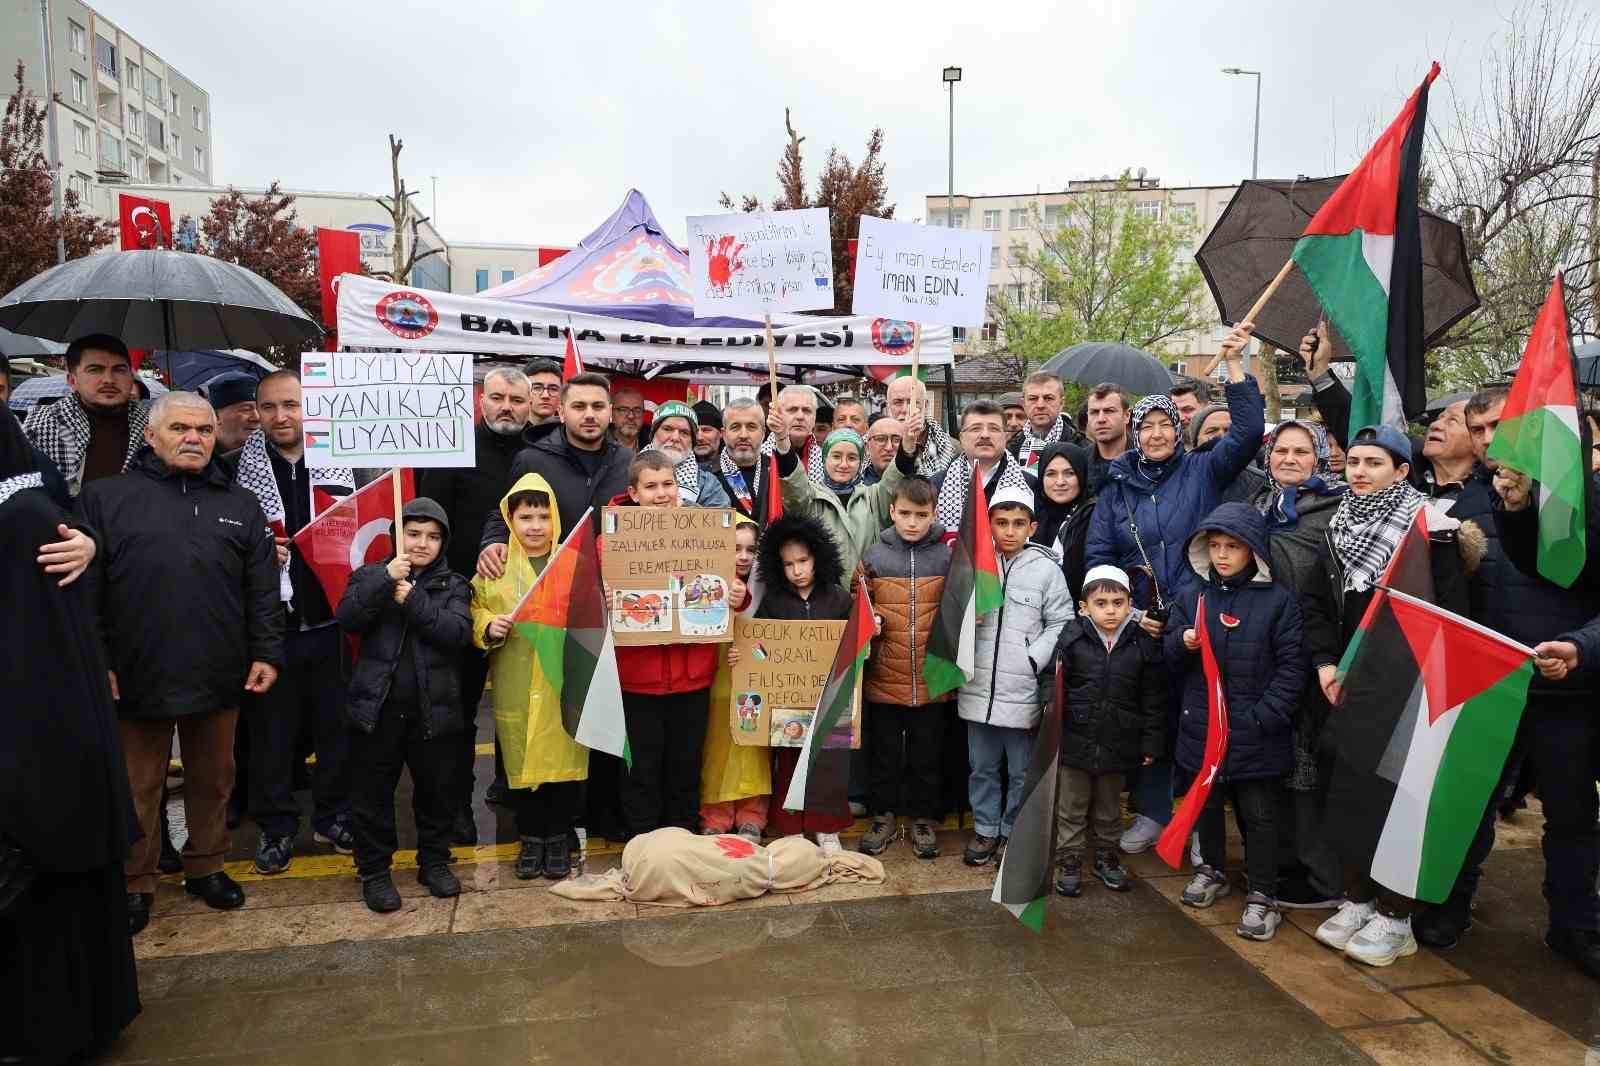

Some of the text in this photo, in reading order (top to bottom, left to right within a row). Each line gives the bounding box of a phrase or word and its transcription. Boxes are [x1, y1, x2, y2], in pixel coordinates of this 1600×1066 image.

[864, 233, 885, 271] Ey
[339, 356, 466, 385] UYUYAN
[305, 386, 472, 418] UYANIKLAR
[338, 419, 457, 450] UYANIN
[671, 511, 698, 531] YOK
